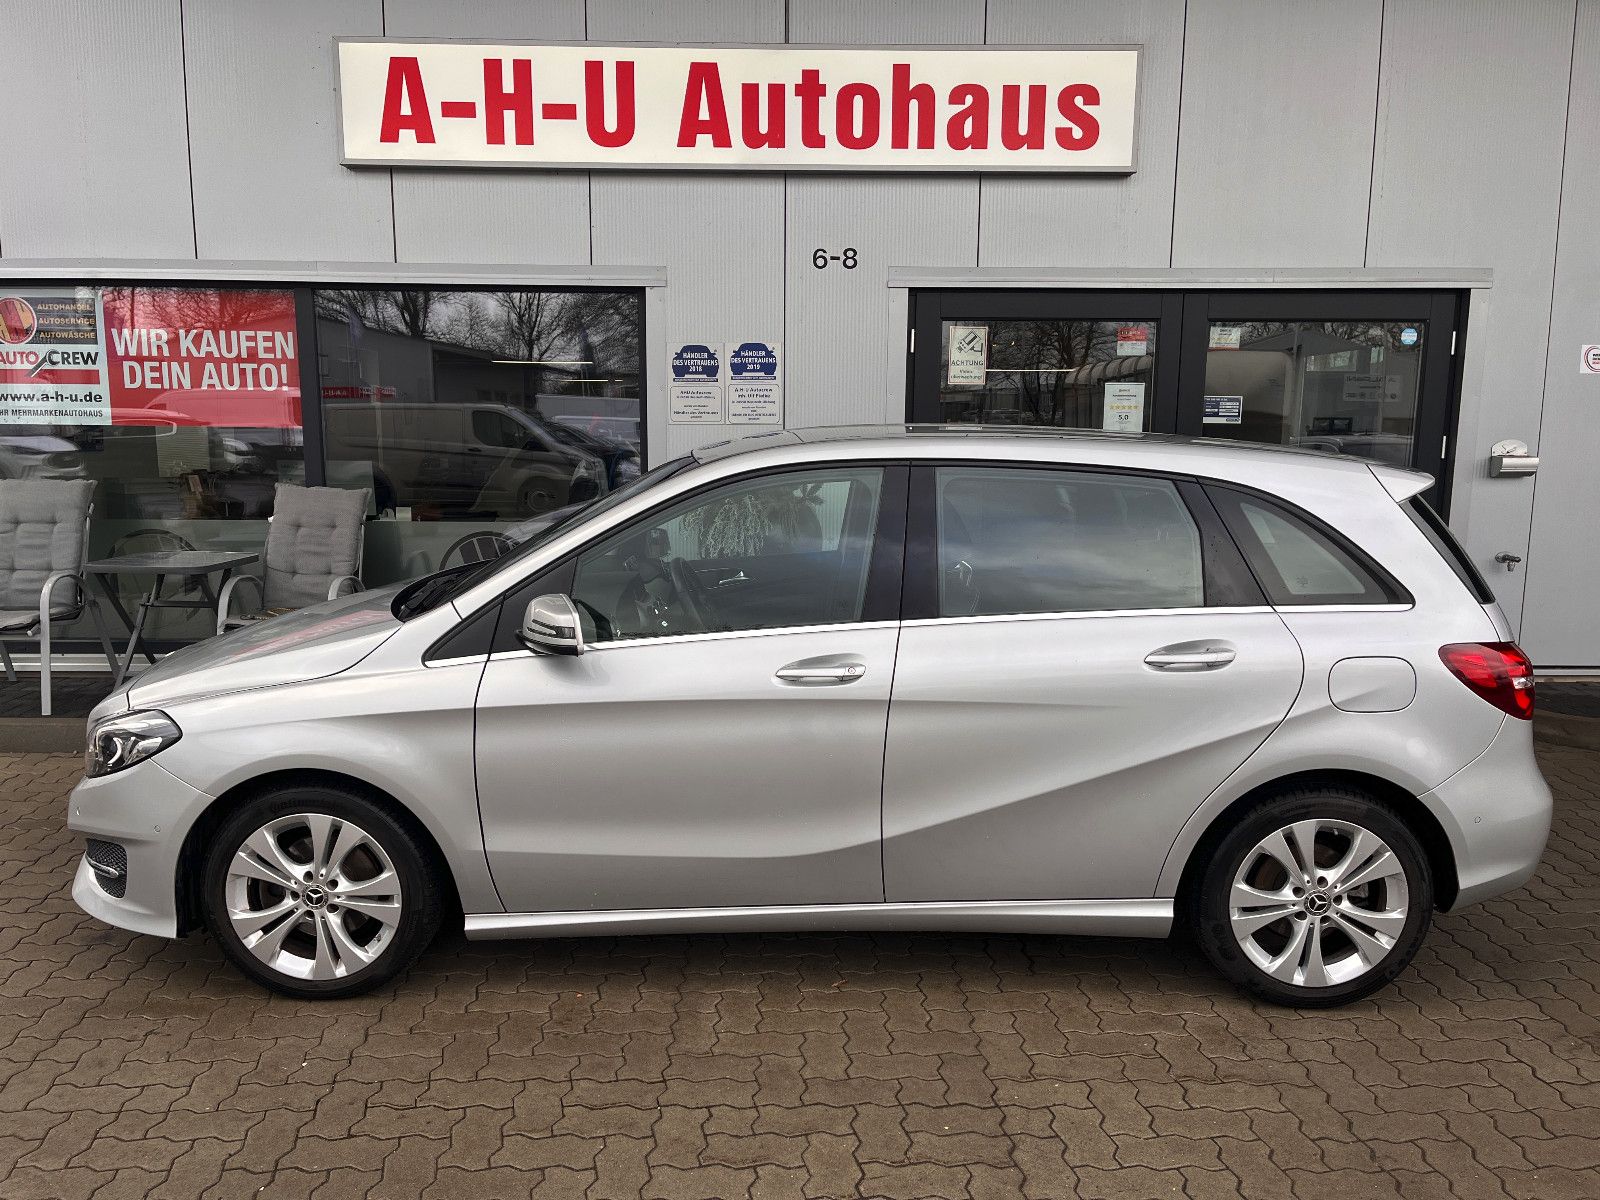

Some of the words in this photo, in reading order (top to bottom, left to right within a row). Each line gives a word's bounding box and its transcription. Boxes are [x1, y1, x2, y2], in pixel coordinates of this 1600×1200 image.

[380, 57, 635, 148] A-H-U
[677, 62, 1101, 151] Autohaus
[812, 247, 858, 270] 6-8
[40, 330, 95, 338] AUTOWÄSCHE
[111, 328, 169, 356] WIR
[178, 329, 295, 359] KAUFEN
[47, 350, 98, 366] CREW
[122, 361, 191, 389] DEIN
[201, 363, 288, 392] AUTO!
[0, 391, 102, 402] www.a-h-u.de
[11, 408, 103, 417] MEHRMARKENAUTOHAUS
